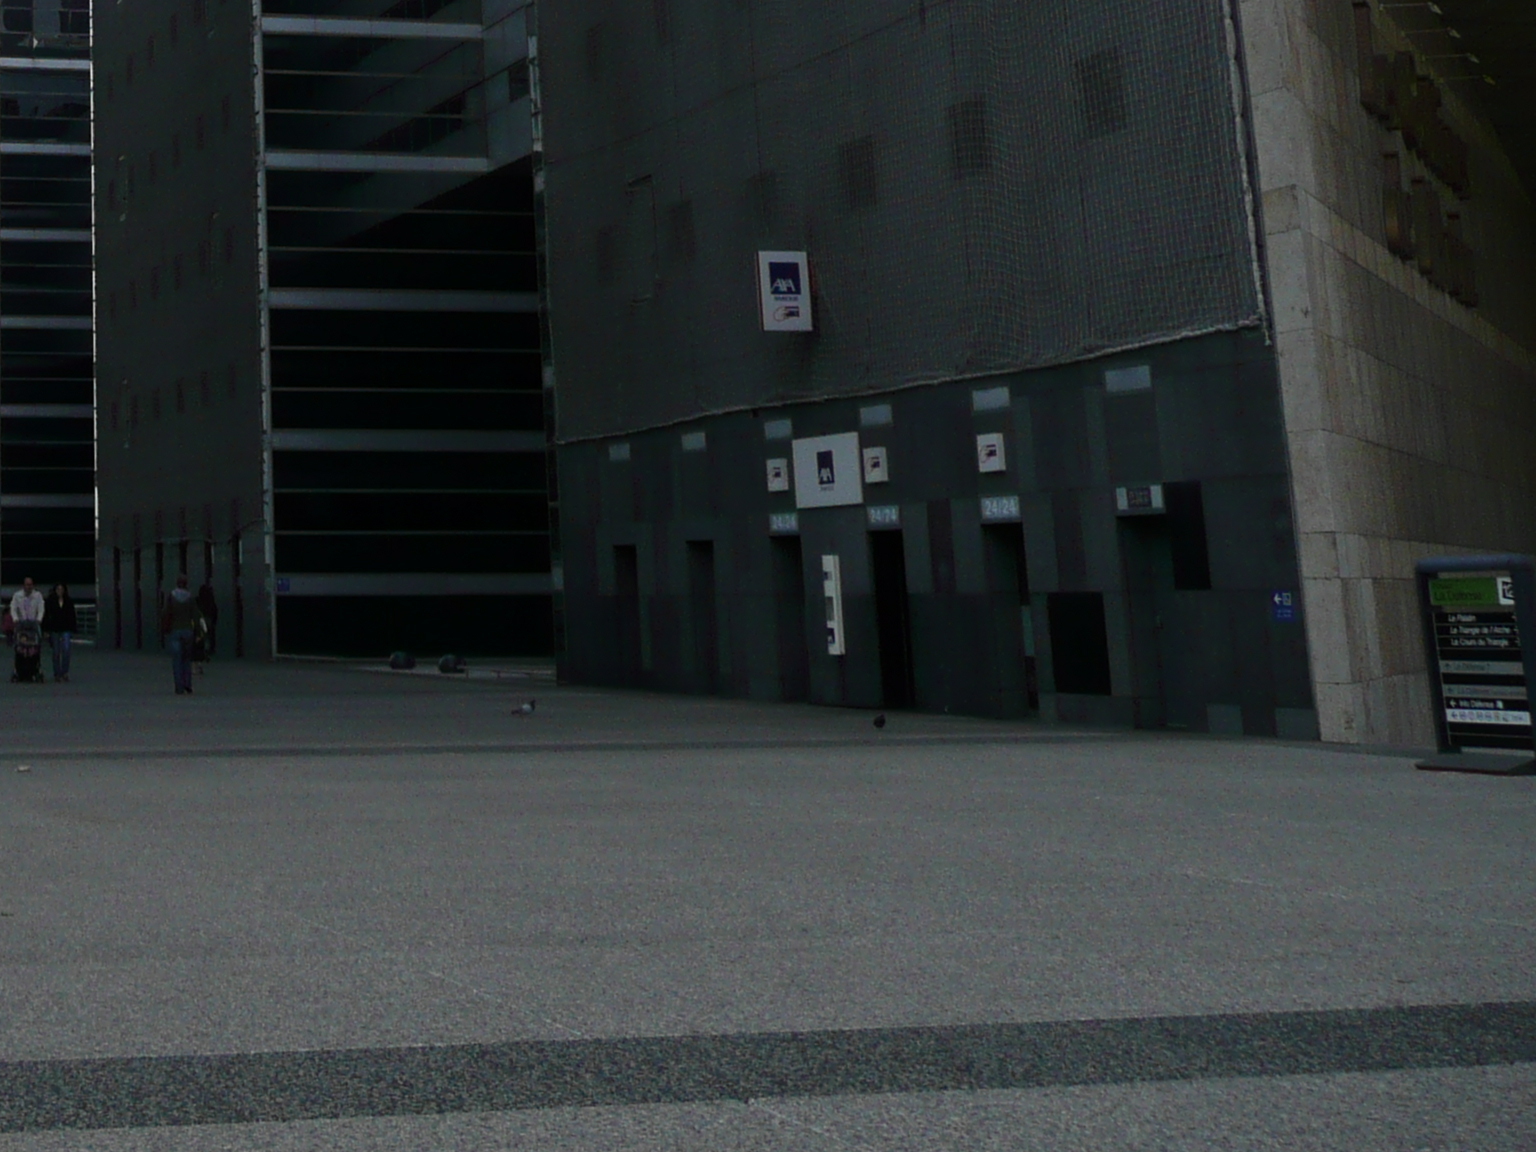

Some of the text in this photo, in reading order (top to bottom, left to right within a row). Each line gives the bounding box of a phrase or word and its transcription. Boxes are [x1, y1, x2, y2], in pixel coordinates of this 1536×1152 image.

[771, 278, 796, 292] AXA
[870, 507, 897, 523] 24/24
[985, 499, 1017, 515] 24/24
